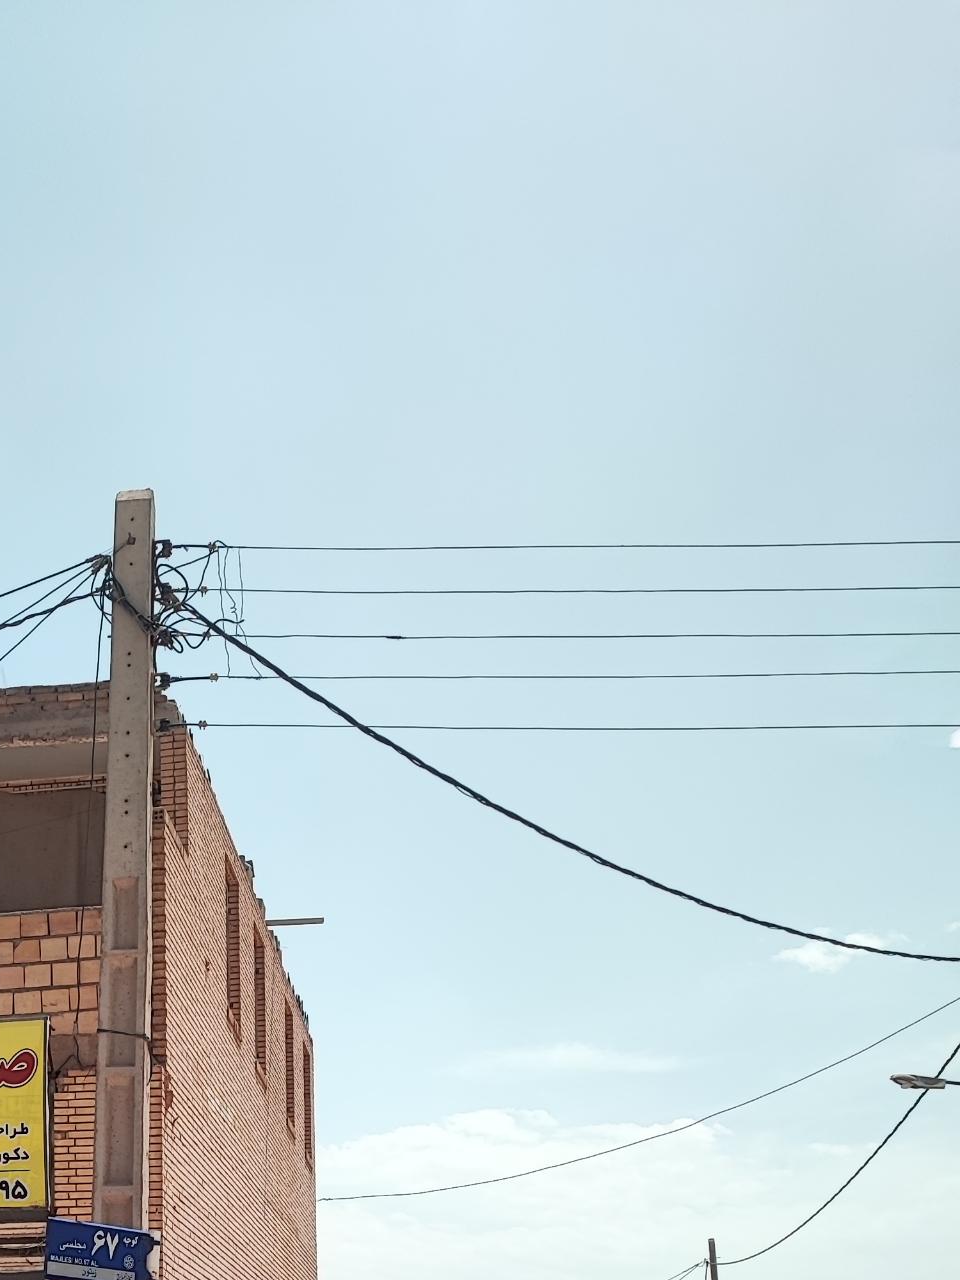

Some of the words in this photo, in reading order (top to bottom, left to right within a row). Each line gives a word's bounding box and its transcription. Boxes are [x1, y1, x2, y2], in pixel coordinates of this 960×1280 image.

[59, 1240, 87, 1253] مجلسی
[91, 1230, 119, 1260] ۶۷
[123, 1236, 139, 1247] کوچه
